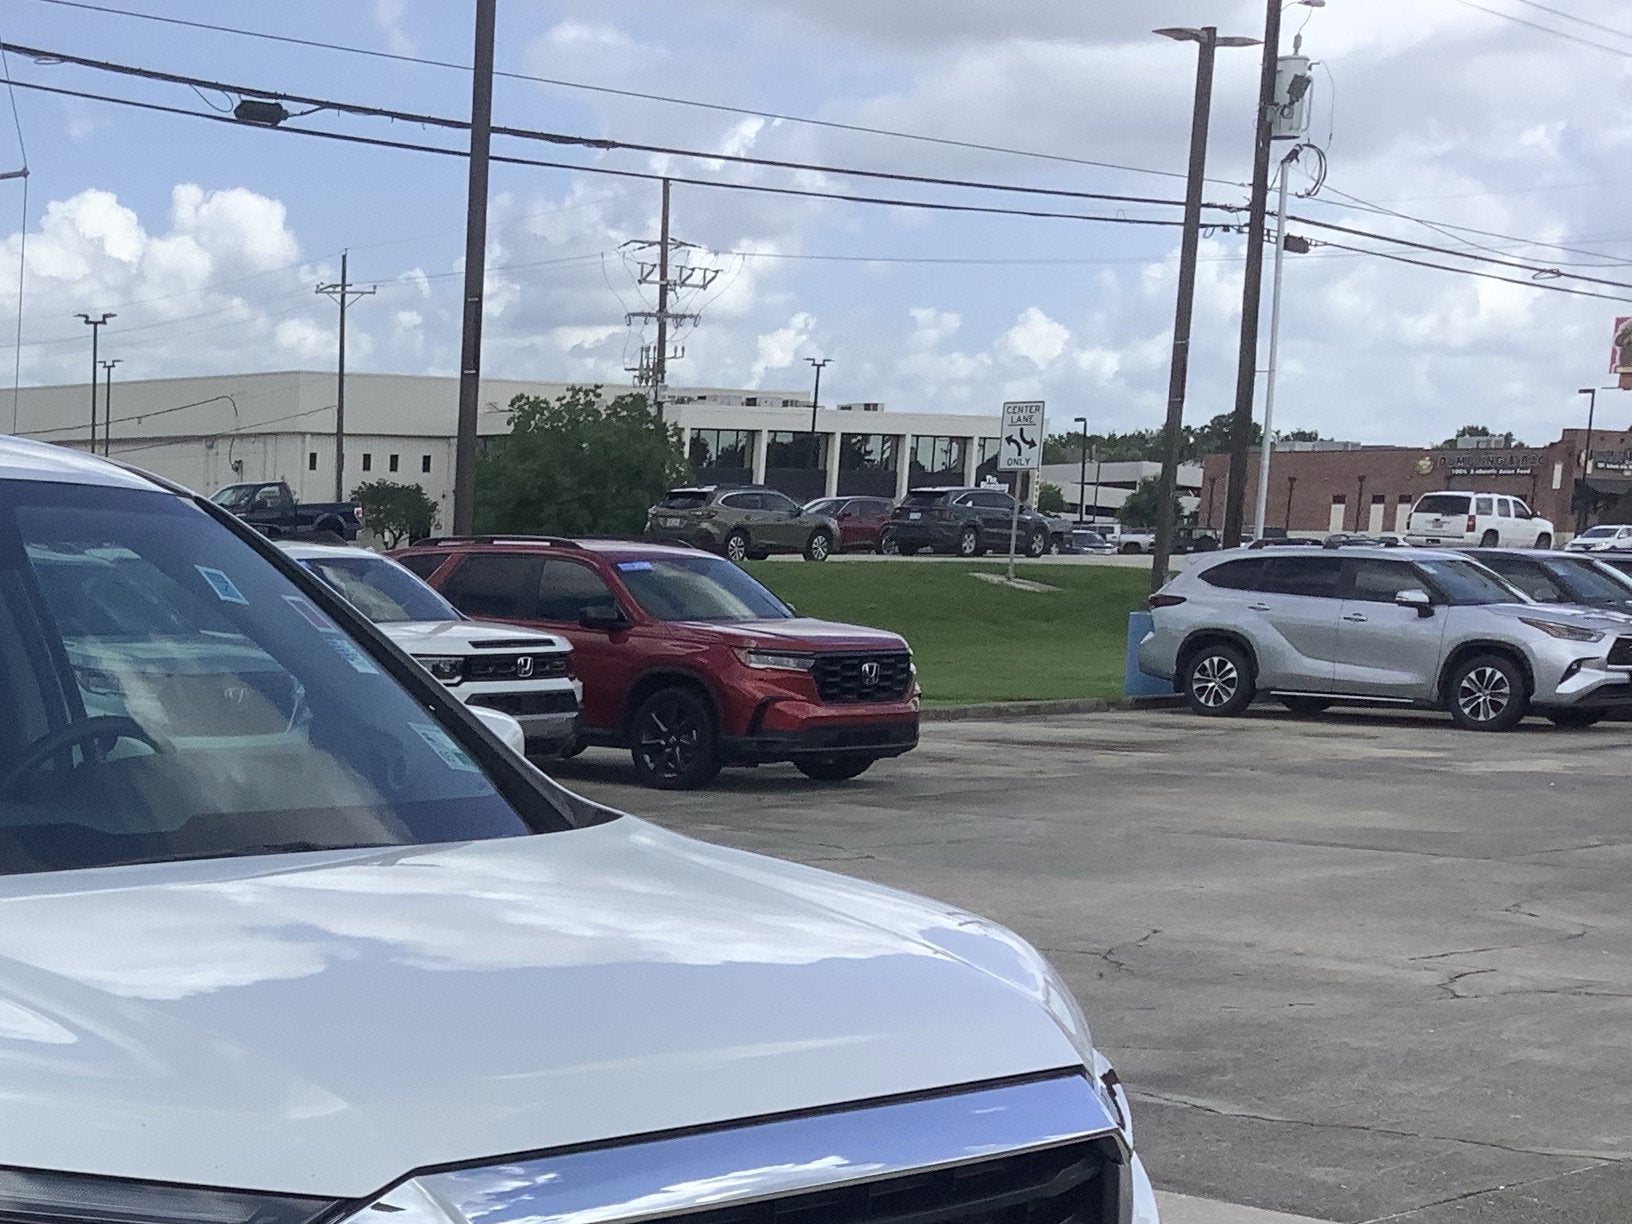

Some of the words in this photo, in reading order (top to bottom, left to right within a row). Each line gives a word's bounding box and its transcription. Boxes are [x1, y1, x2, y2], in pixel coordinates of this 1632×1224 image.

[1006, 405, 1041, 415] CENTER
[1010, 414, 1035, 424] LANE
[1006, 457, 1031, 467] ONLY
